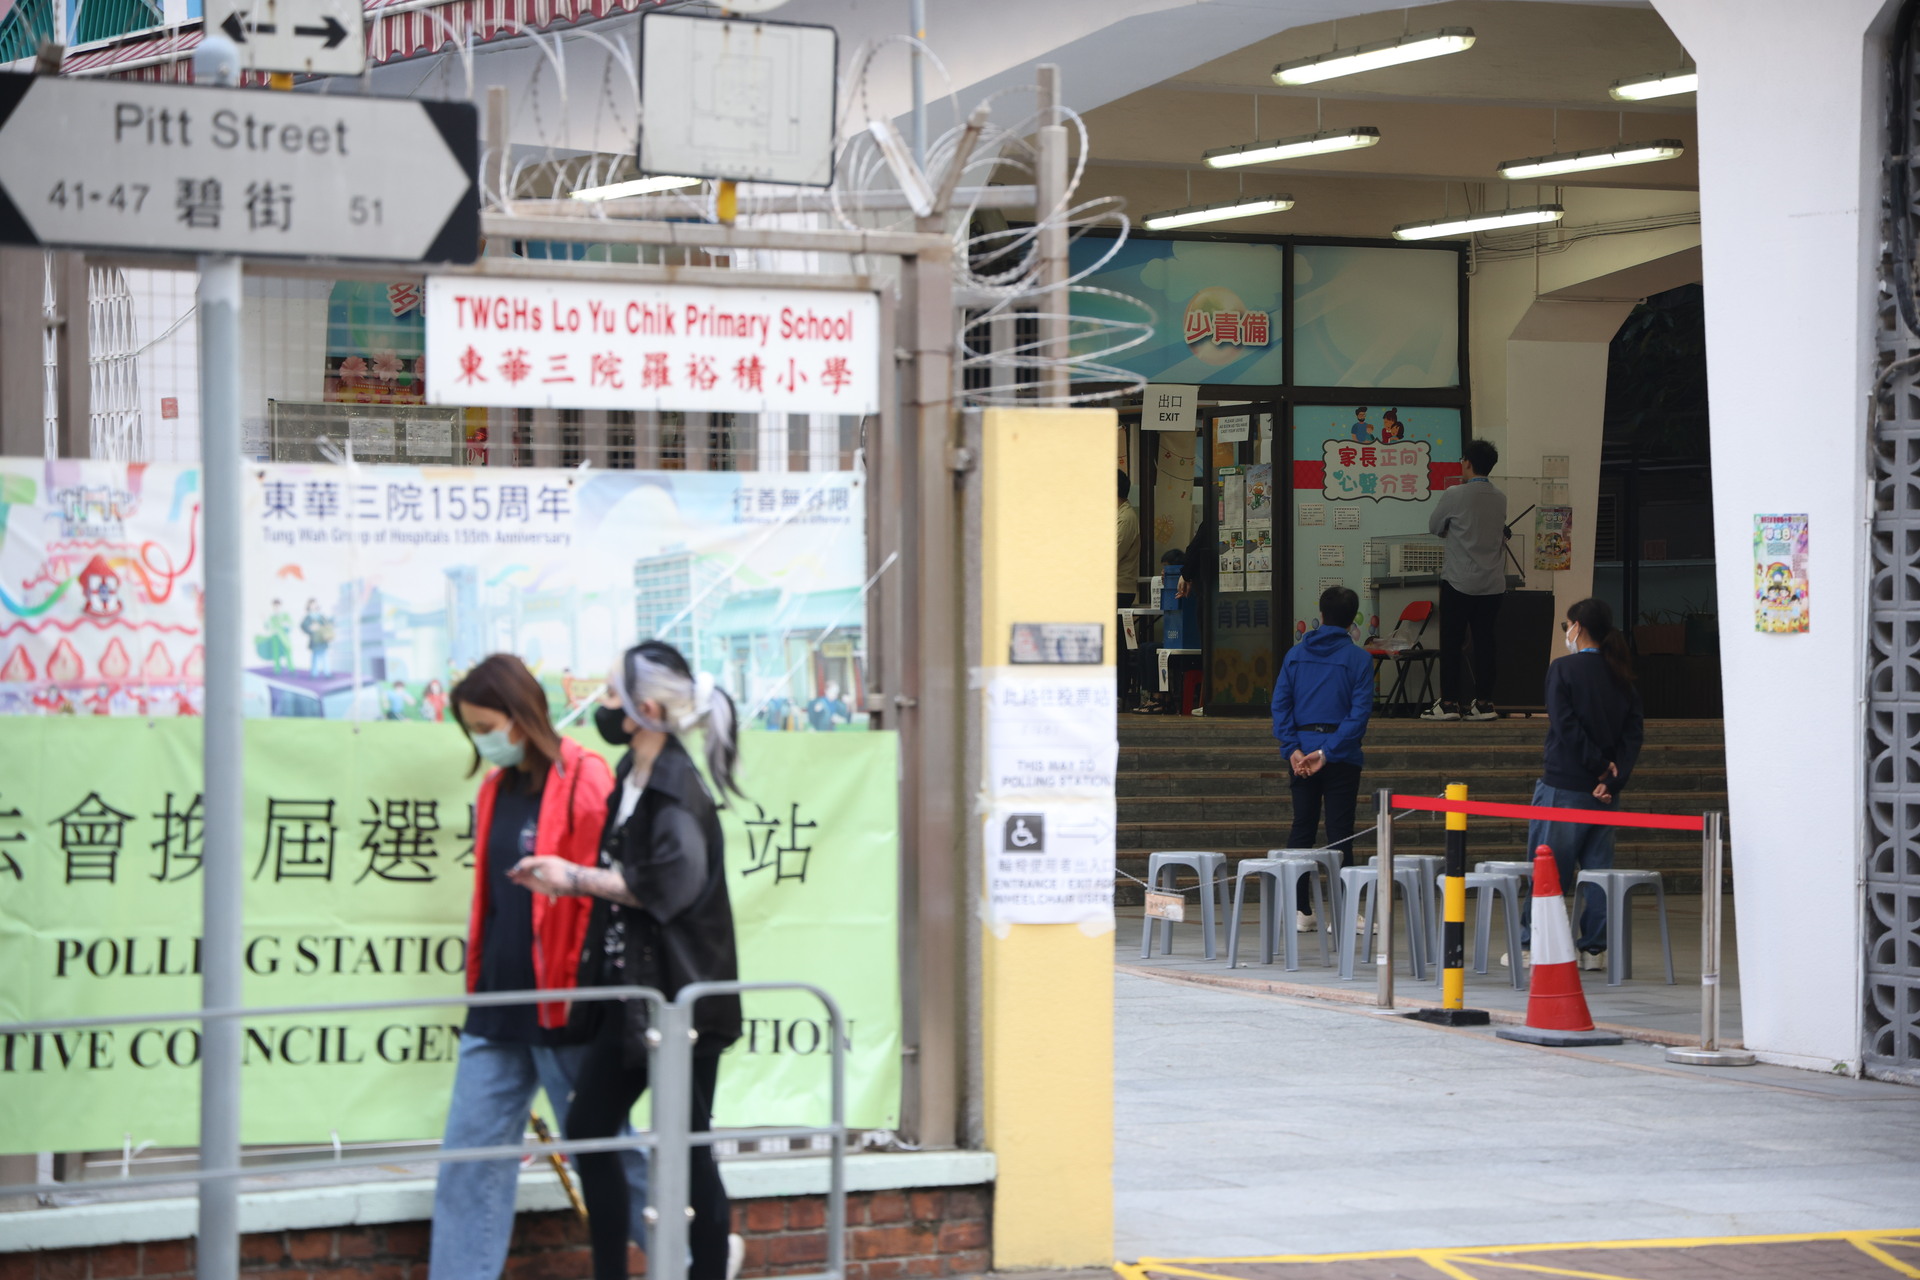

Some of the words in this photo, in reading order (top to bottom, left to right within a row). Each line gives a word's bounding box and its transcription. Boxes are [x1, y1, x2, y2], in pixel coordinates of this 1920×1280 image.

[115, 103, 192, 147] Pitt
[211, 109, 348, 155] Street
[49, 180, 150, 213] 41-47
[176, 178, 292, 232] 碧街
[349, 196, 383, 226] 51
[454, 296, 541, 331] TWGHs
[552, 299, 580, 332] Lo
[589, 302, 615, 333] Yu
[626, 303, 675, 335] Chik
[686, 305, 769, 347] Primary
[781, 307, 853, 341] School
[1185, 312, 1268, 344] 少責備
[455, 344, 853, 394] 東華三院羅裕積小學
[1158, 394, 1182, 408] 出口
[1159, 413, 1180, 421] EXIT
[1338, 446, 1418, 467] 家長正向
[262, 481, 571, 522] 東華三院155周年
[263, 527, 294, 546] Tung
[298, 527, 328, 543] Wah
[331, 526, 371, 546] Grp
[390, 527, 449, 547] Hospitals
[496, 530, 571, 547] Anniversary
[1017, 760, 1043, 772] THIS
[1079, 760, 1096, 772] TO
[54, 936, 281, 978] POLLIG
[295, 935, 467, 976] STATIO
[129, 1025, 364, 1069] CONCIL
[722, 1018, 856, 1056] TION
